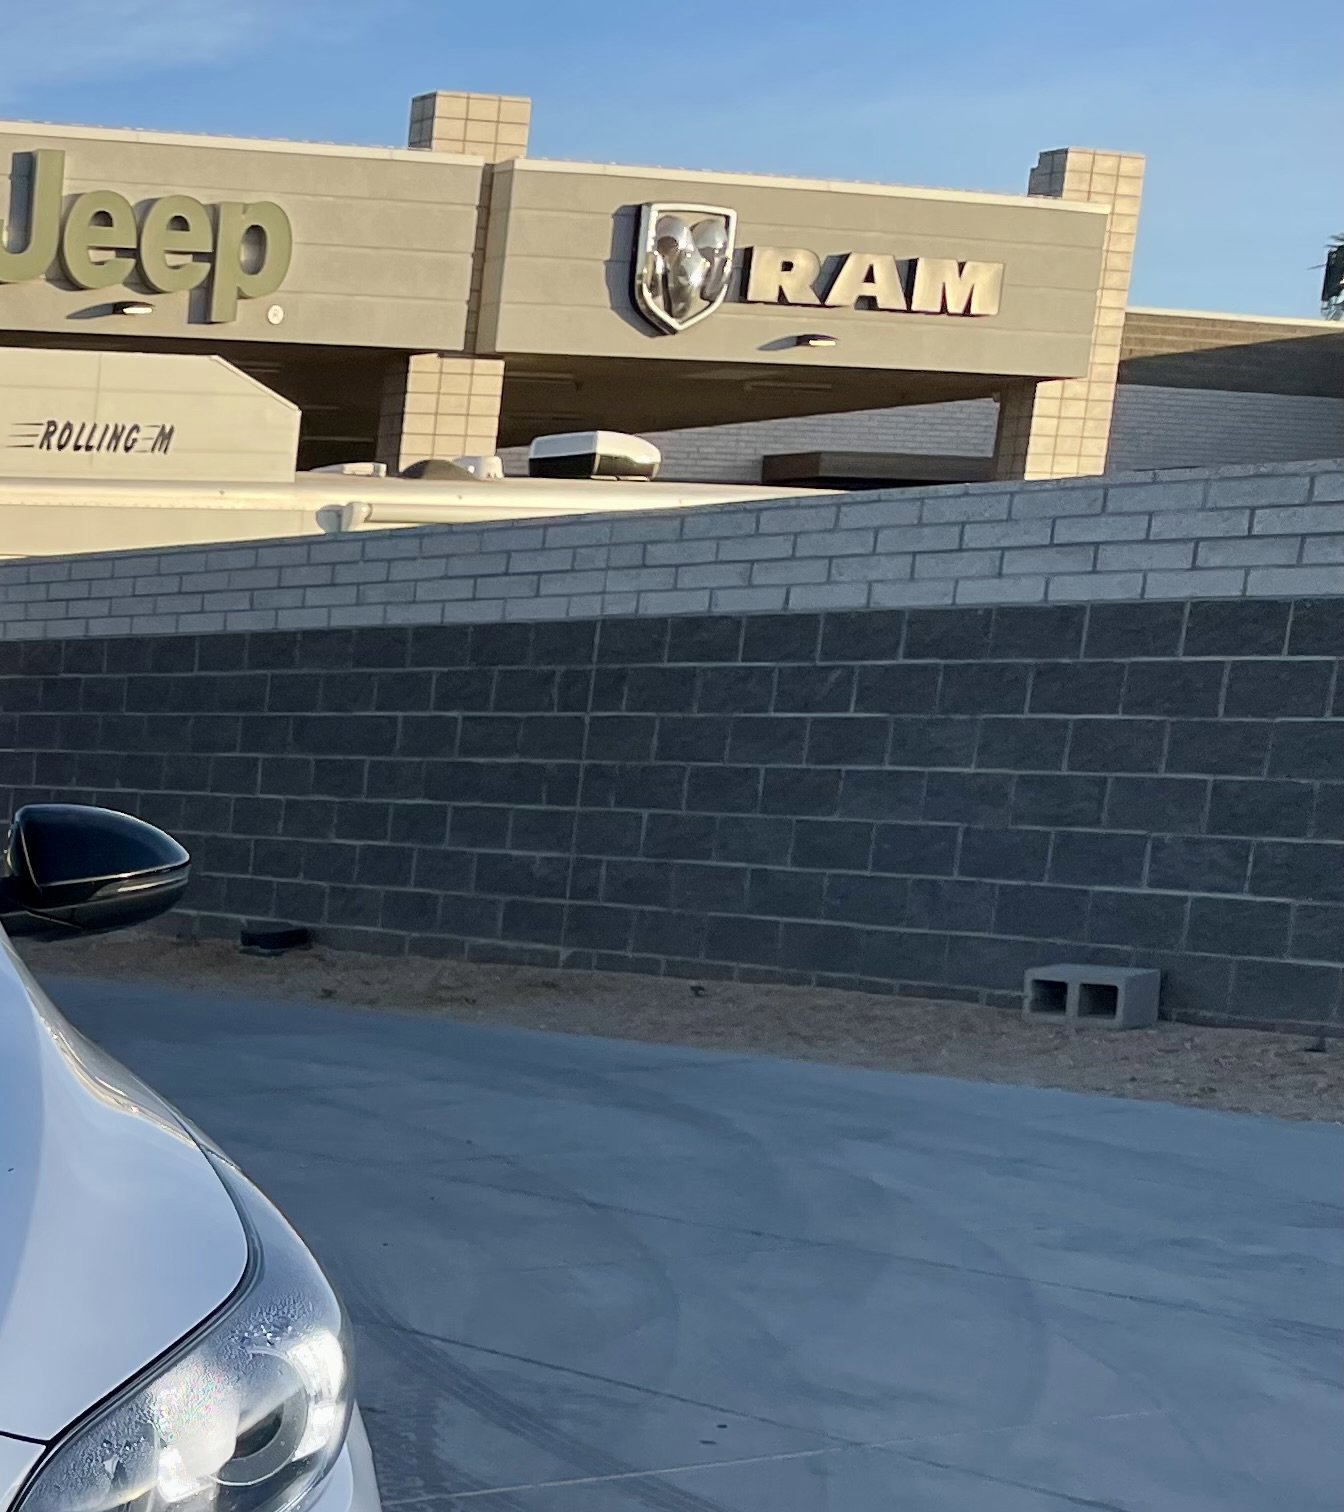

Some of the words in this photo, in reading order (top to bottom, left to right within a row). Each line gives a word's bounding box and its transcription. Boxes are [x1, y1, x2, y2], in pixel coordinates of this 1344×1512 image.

[745, 245, 1006, 317] RAM
[38, 420, 141, 453] ROLLING
[150, 423, 175, 455] M
